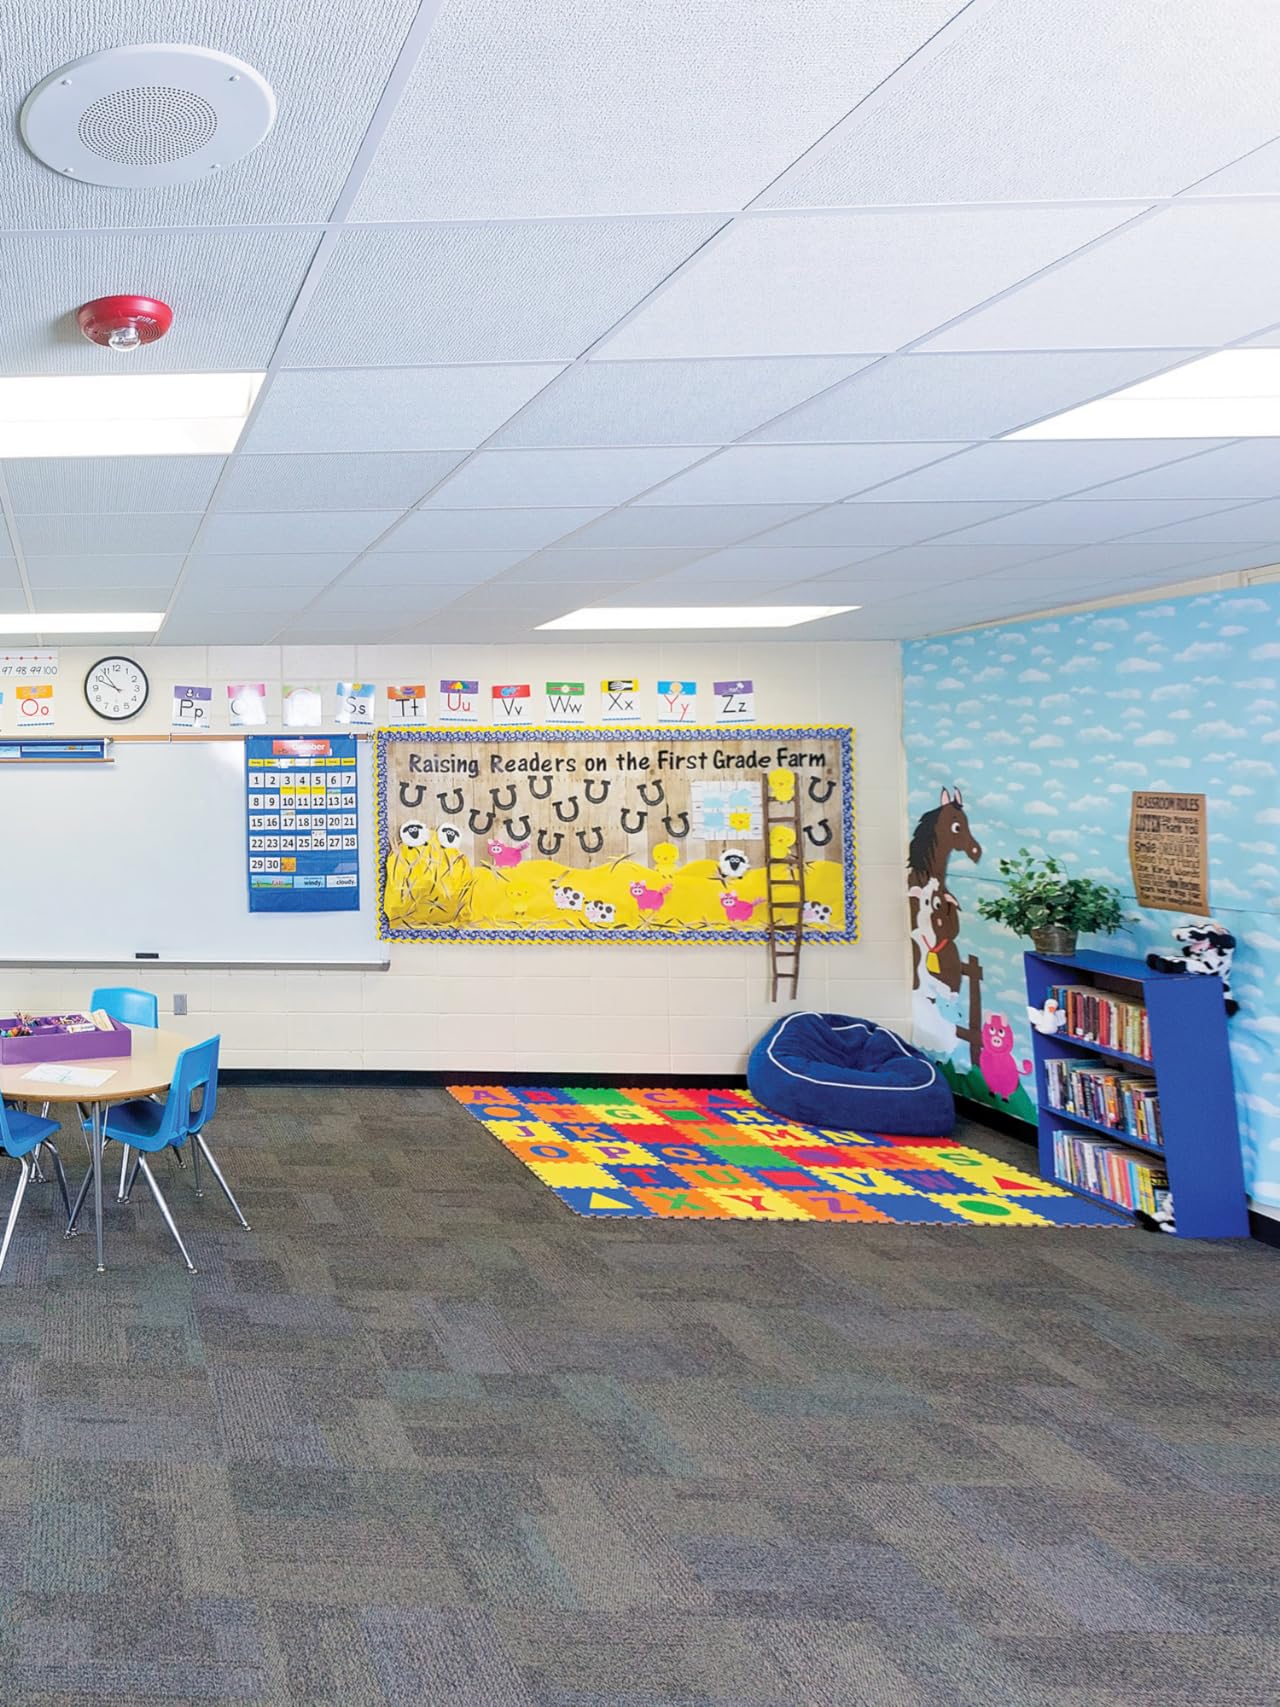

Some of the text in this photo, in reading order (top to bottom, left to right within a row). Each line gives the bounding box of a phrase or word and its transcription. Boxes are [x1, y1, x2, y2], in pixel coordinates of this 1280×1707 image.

[2, 666, 12, 675] 97
[16, 666, 27, 675] 98
[30, 666, 41, 675] 99
[43, 666, 57, 675] 100
[112, 664, 120, 672] 12
[21, 699, 48, 716] Oo
[180, 700, 204, 720] Pp
[346, 696, 366, 714] Ss
[396, 698, 418, 716] Tt
[447, 693, 470, 712] Uu
[502, 699, 522, 716] Vv
[548, 696, 582, 714] Ww
[608, 693, 633, 711] Xx
[664, 694, 689, 720] Yy
[722, 694, 747, 713] Zz
[409, 748, 826, 778] Raising Readers on the First Grade Farm
[270, 776, 275, 784] 2
[285, 776, 290, 785] 3
[316, 776, 321, 785] 5
[331, 776, 336, 784] 6
[346, 776, 351, 784] 7
[254, 797, 353, 806] 8 9 10 11 12 13 14
[252, 817, 354, 827] 15 16 17 18 19 20 21
[252, 837, 355, 848] 22 23 24 25 26 27 28
[252, 860, 278, 869] 29 30
[472, 1090, 676, 1103] A B C
[605, 1109, 642, 1119] G
[722, 1110, 774, 1122] H
[514, 1126, 874, 1144] J K L M N
[530, 1146, 982, 1166] O P Q R S
[618, 1168, 956, 1190] T U V W
[651, 1192, 860, 1214] X Y Z
